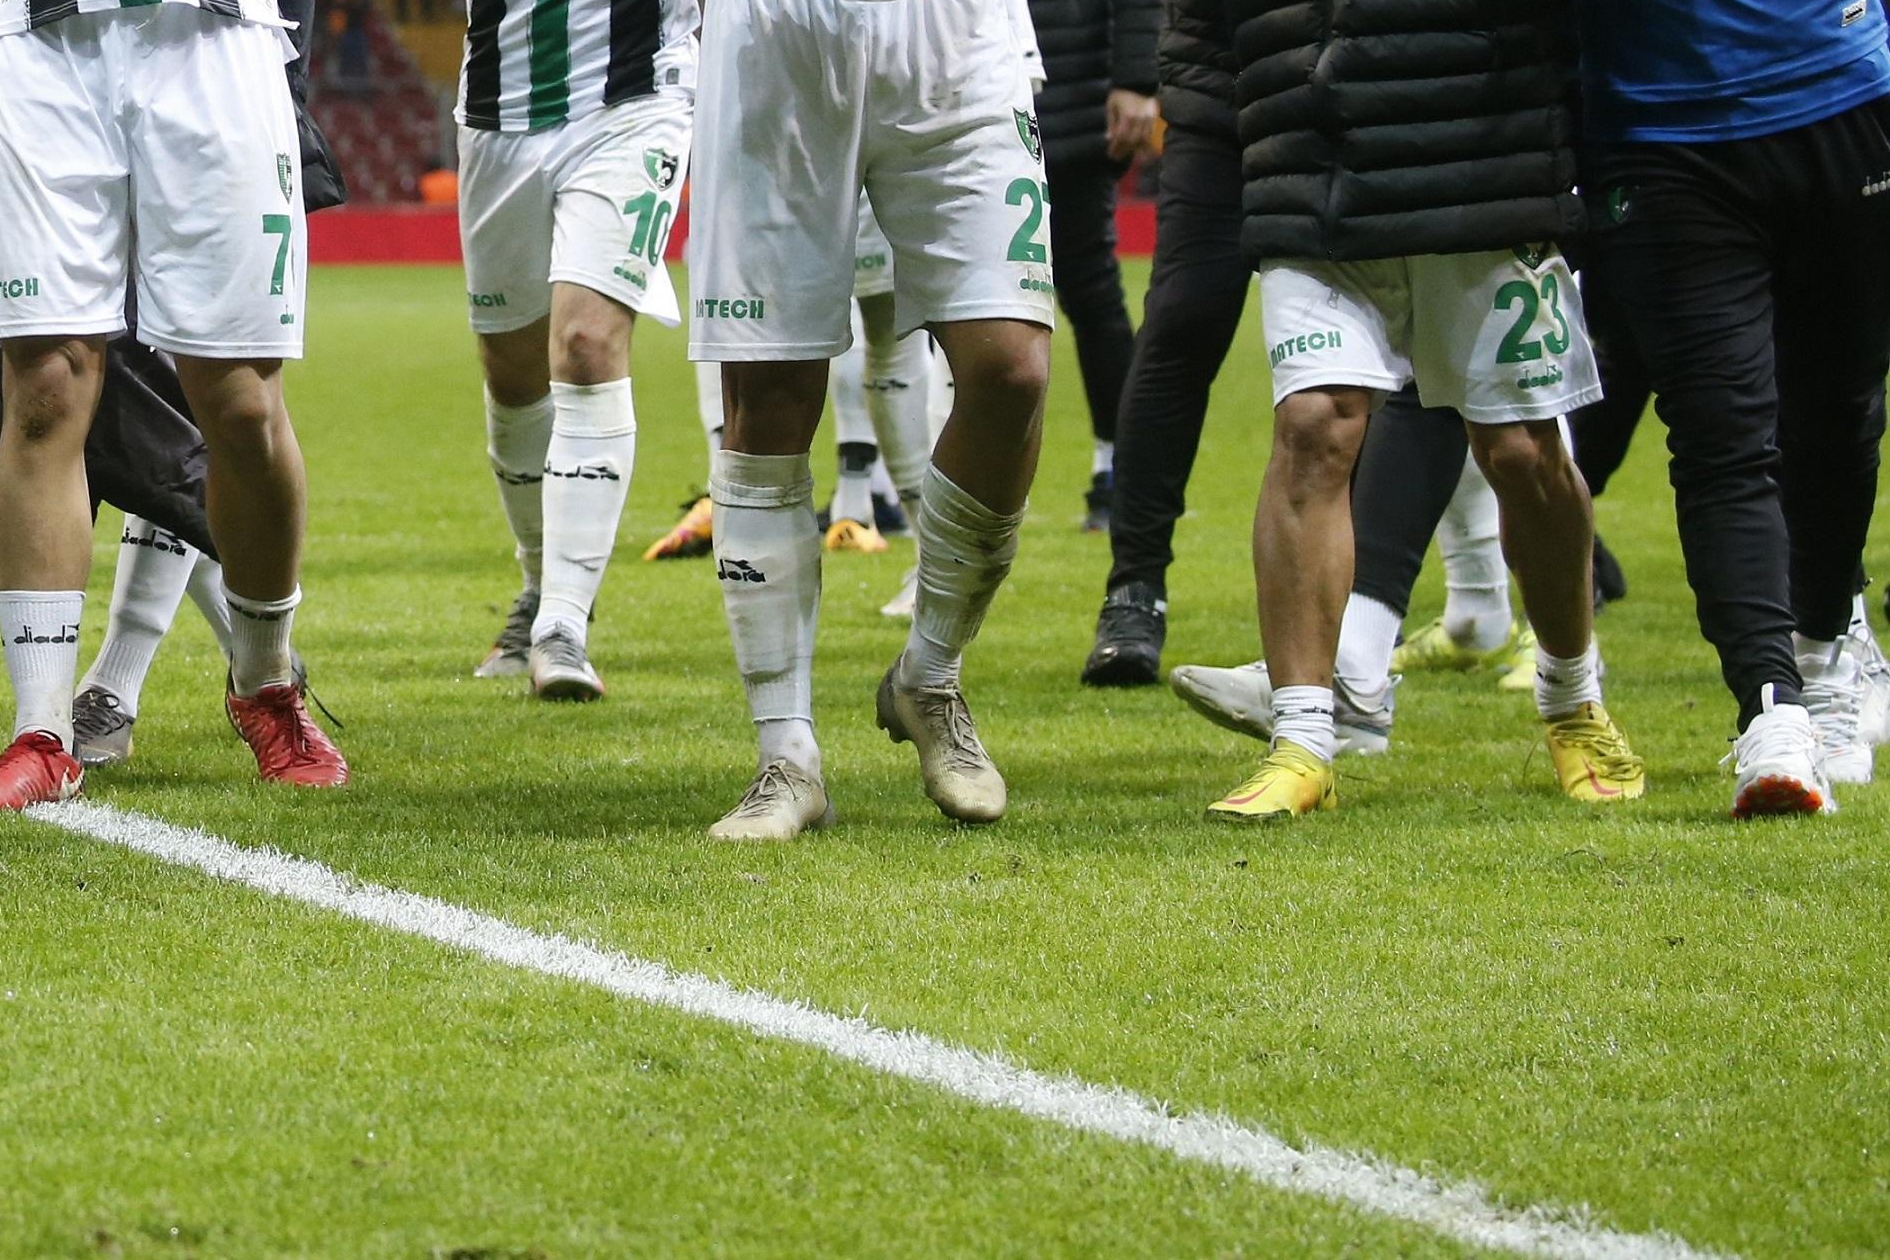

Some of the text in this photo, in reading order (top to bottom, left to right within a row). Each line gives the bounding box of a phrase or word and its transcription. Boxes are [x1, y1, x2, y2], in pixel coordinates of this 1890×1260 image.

[262, 213, 292, 295] 7
[623, 190, 672, 267] 10
[1493, 272, 1570, 365] 23
